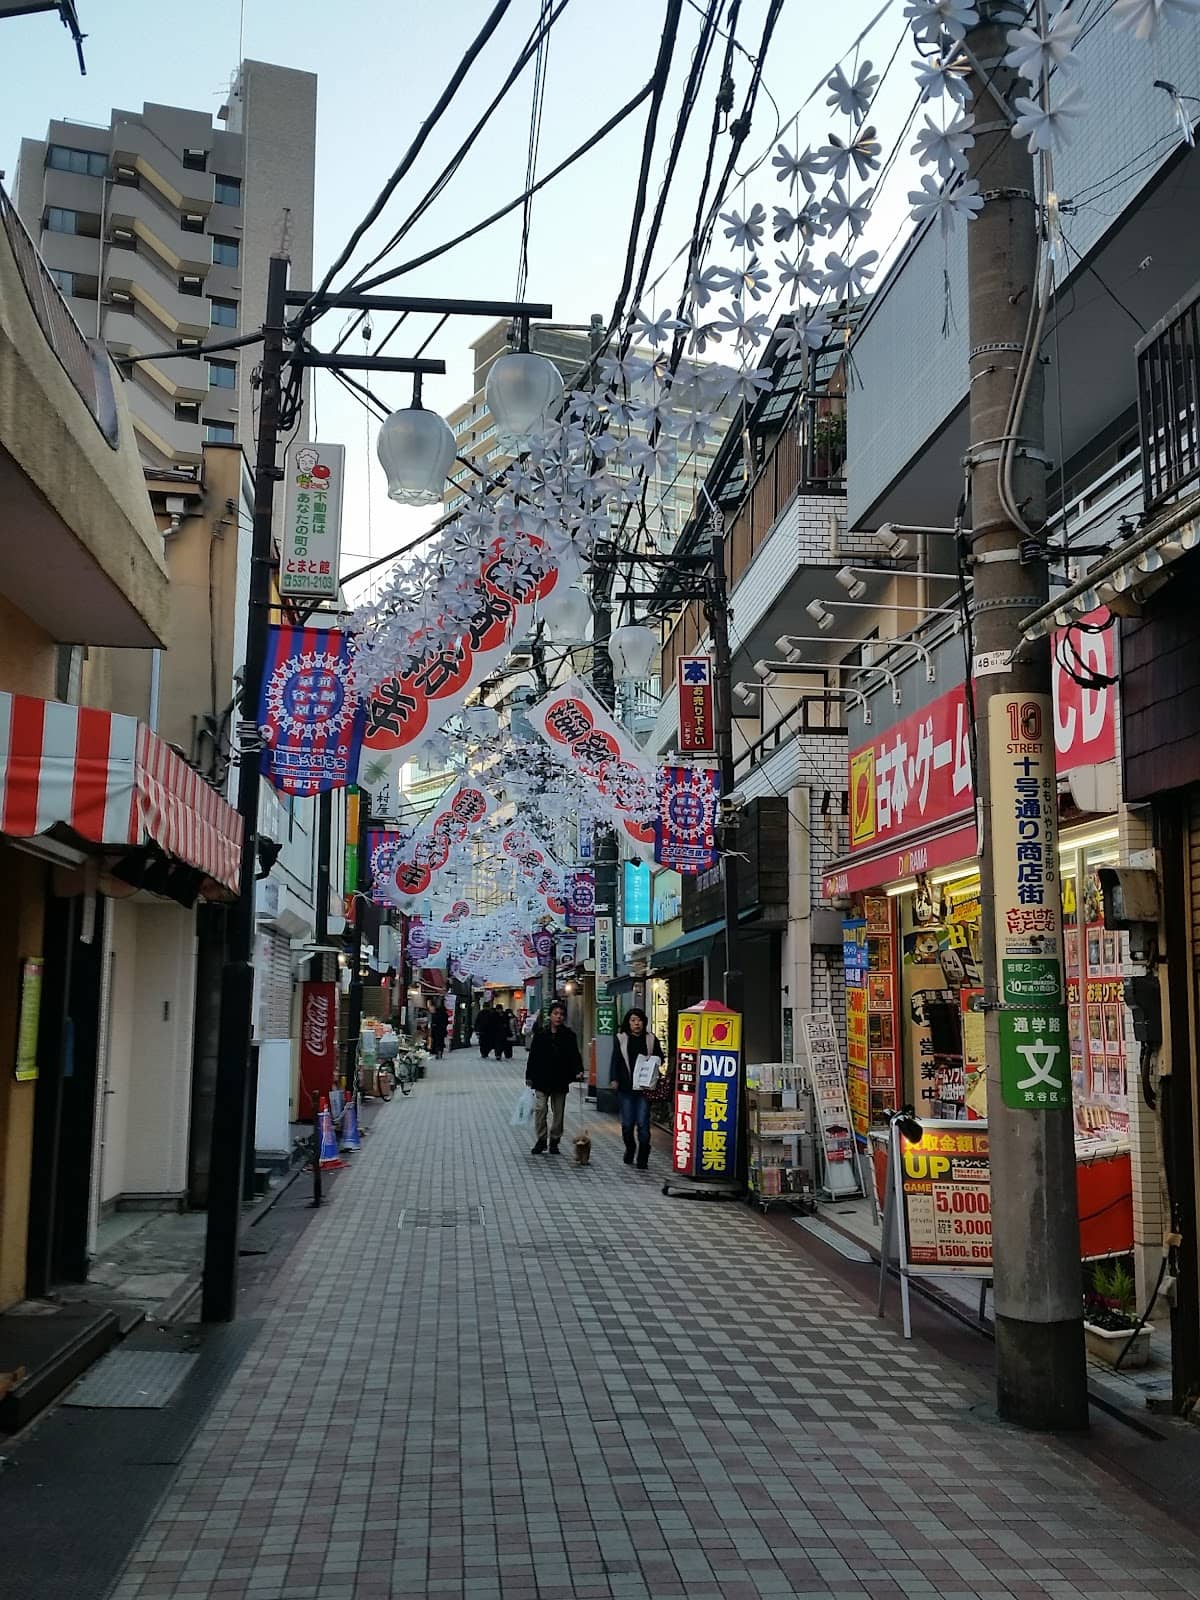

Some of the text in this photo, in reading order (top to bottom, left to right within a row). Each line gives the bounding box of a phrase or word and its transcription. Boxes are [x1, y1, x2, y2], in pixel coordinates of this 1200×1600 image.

[294, 493, 310, 557] あなたの町の
[313, 491, 327, 534] 不動産は
[286, 558, 330, 575] とまと館
[684, 661, 706, 684] 本
[1052, 627, 1106, 753] CD
[692, 686, 705, 745] お売り下さい
[1006, 702, 1041, 740] 10
[1007, 744, 1044, 754] STREET
[876, 703, 973, 832] 古本・ゲーム
[1013, 756, 1044, 905] 十号通り商店街
[1006, 908, 1055, 921] ささはた
[1006, 920, 1055, 934] ドッとこむ
[1013, 1017, 1060, 1033] 通学路
[700, 1055, 737, 1077] DVD
[1015, 1039, 1062, 1089] 文
[1024, 1091, 1059, 1102] 渋谷区
[676, 1094, 693, 1169] 買います
[702, 1083, 728, 1171] 買取・販売
[904, 1151, 950, 1179] UP
[904, 1183, 932, 1192] GAME
